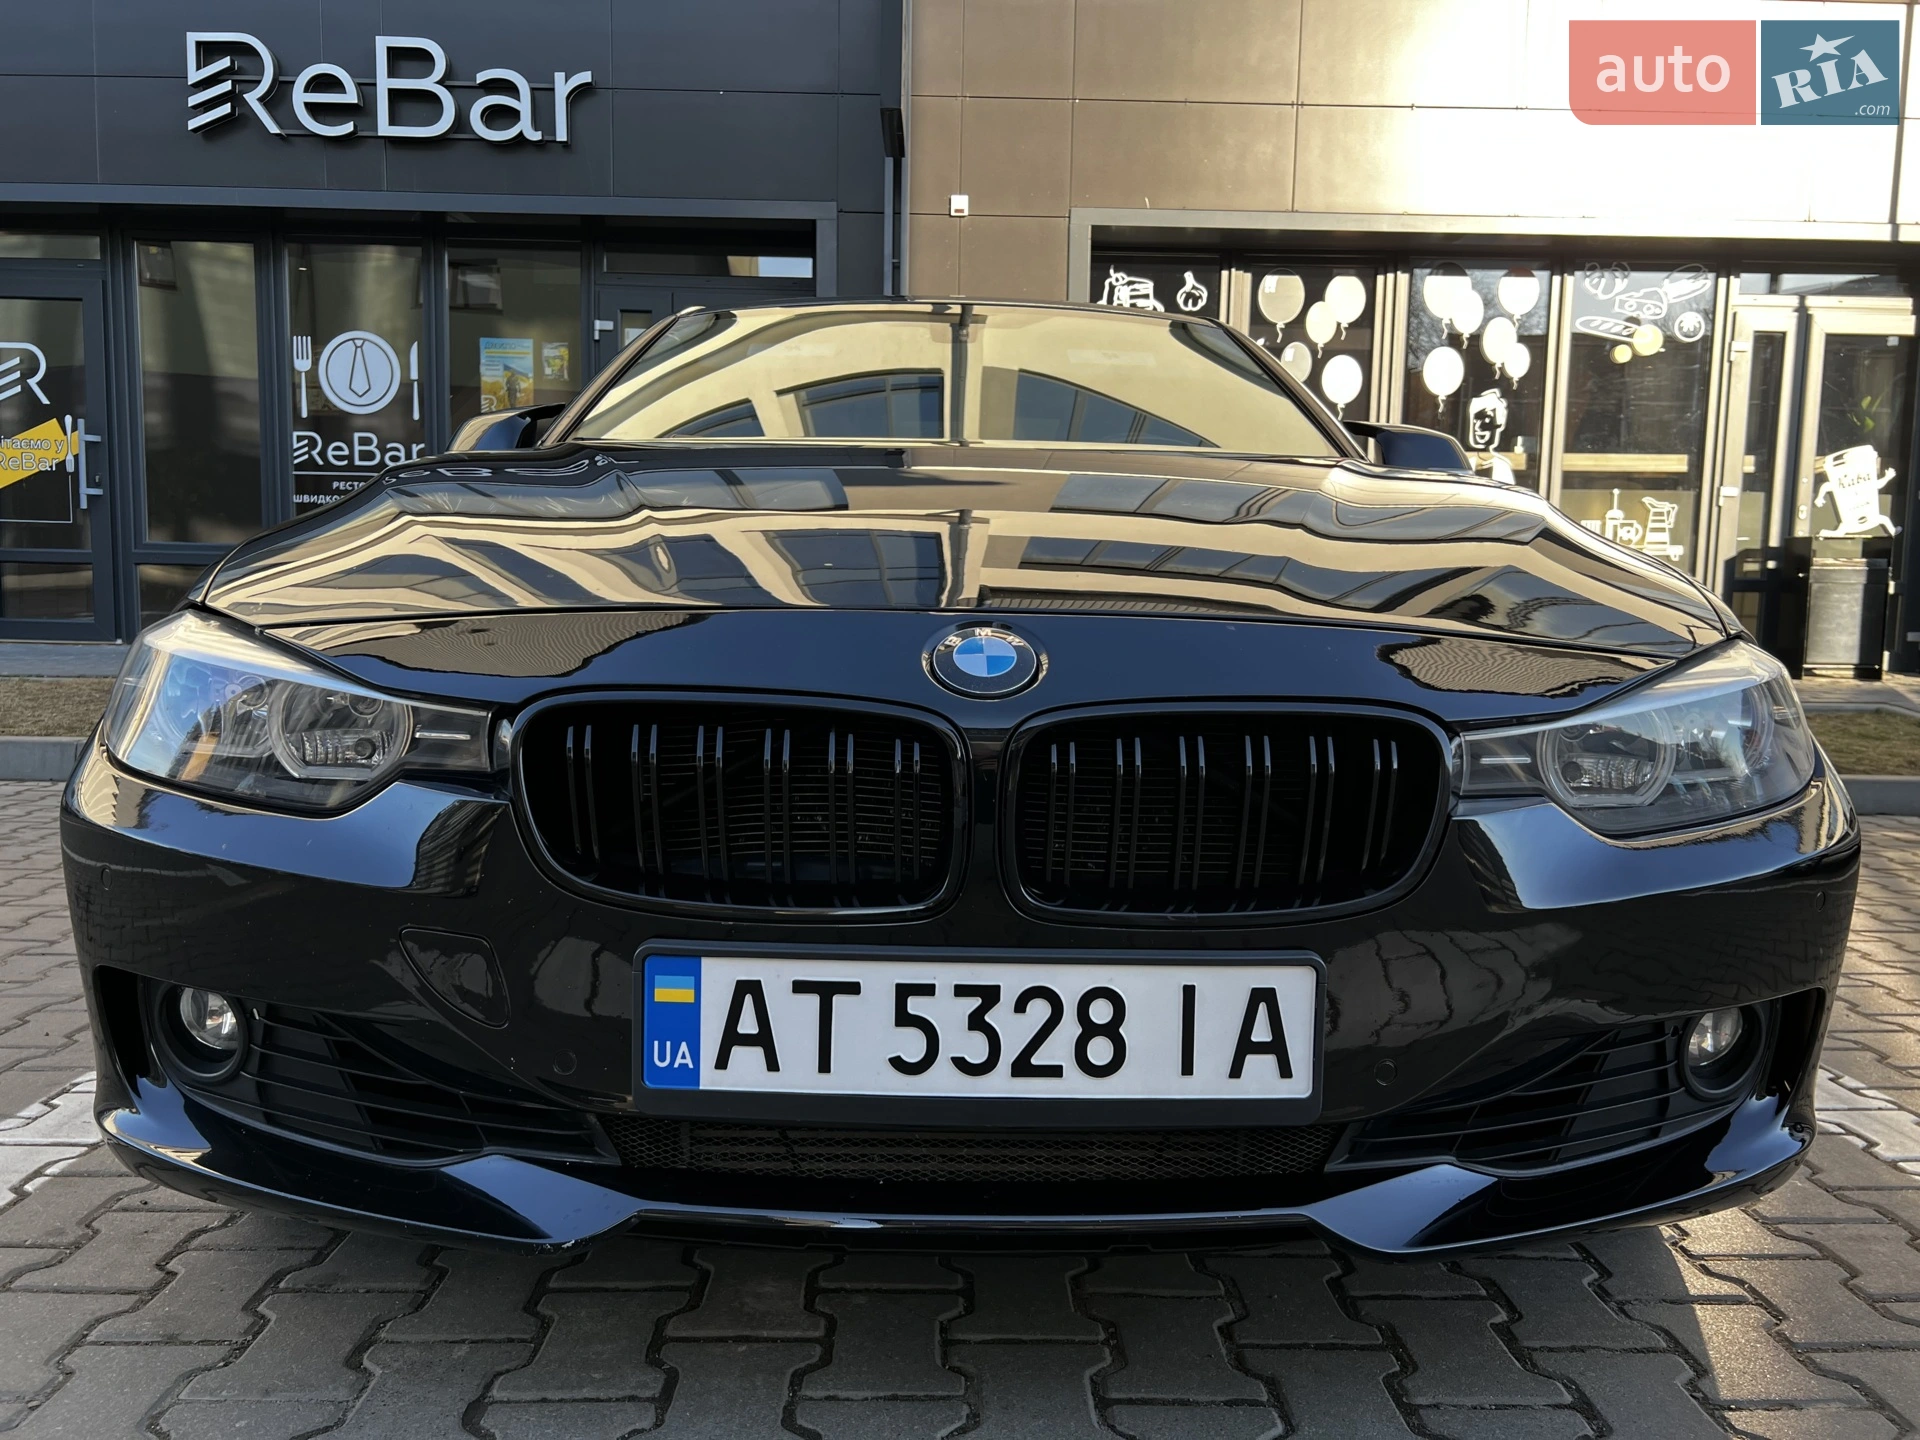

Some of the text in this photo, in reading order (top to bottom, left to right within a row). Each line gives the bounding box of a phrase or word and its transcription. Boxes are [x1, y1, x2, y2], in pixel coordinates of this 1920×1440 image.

[186, 32, 593, 142] ReBar
[0, 435, 51, 450] ітаємо
[292, 431, 426, 467] ReBar
[293, 494, 346, 504] ШВИДКО
[714, 979, 1294, 1080] AT 5328 IA
[653, 1040, 694, 1069] UA
